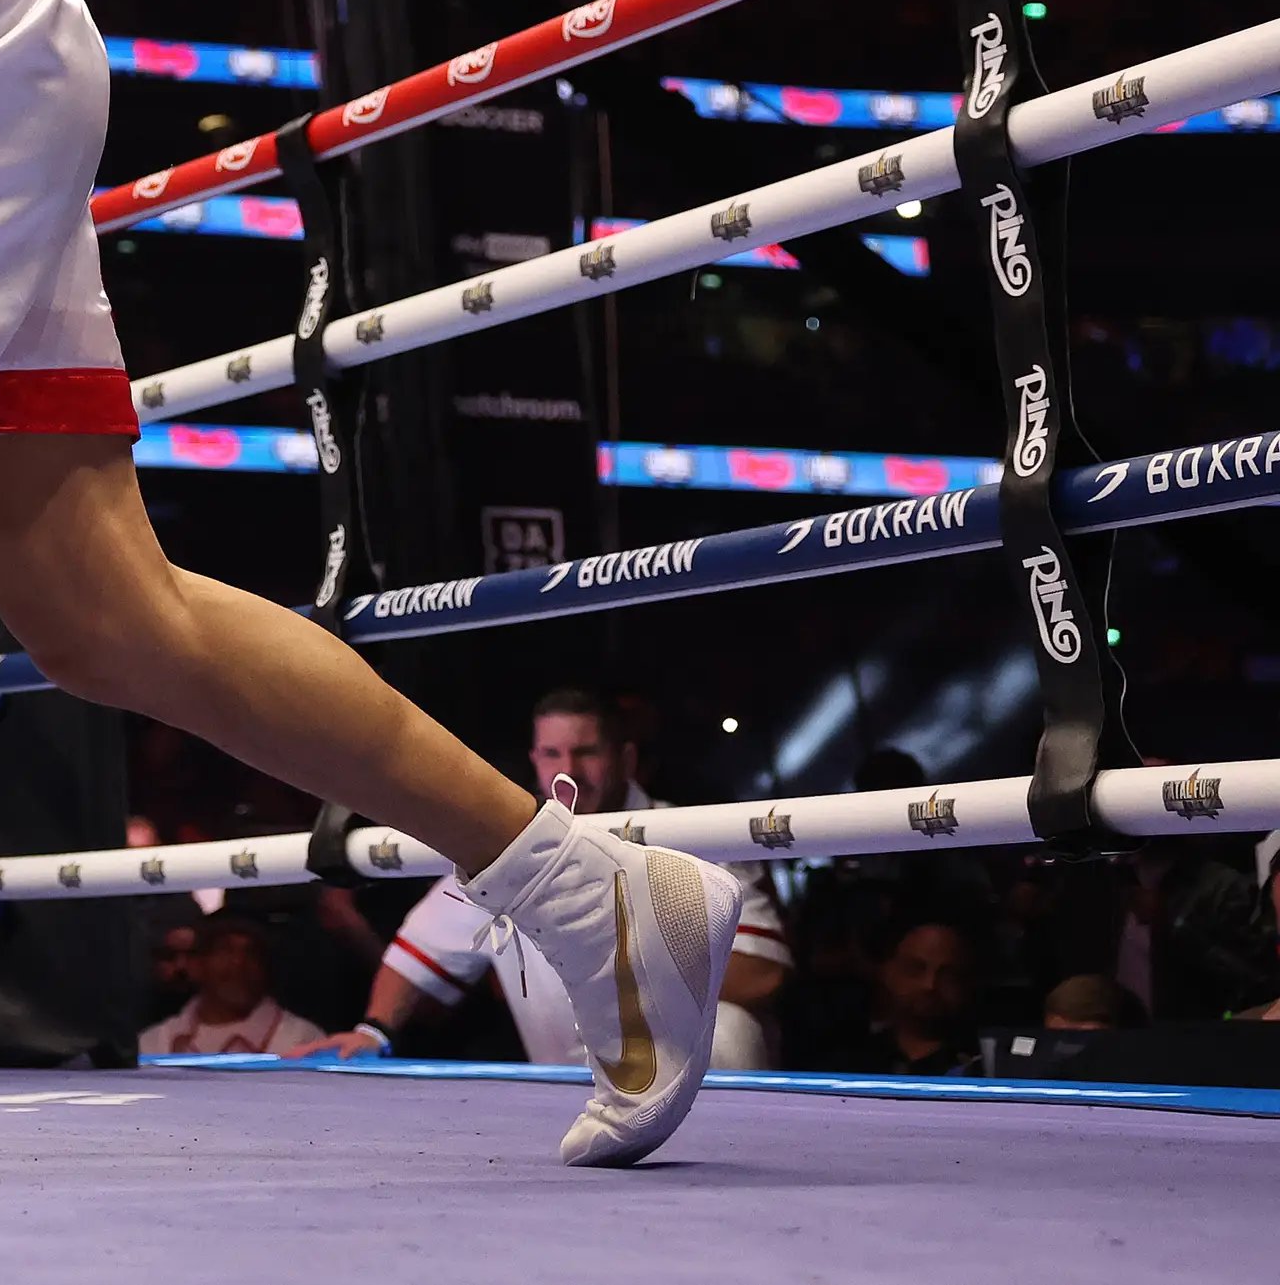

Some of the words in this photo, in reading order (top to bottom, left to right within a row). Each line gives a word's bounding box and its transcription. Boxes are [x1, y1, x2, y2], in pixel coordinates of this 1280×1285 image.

[968, 13, 1008, 119] RING
[980, 183, 1032, 297] RING
[1014, 364, 1051, 478] RING
[577, 538, 704, 588] BOXRAW
[824, 488, 976, 549] BOXRAW
[375, 576, 484, 618] BOXRAW
[1022, 546, 1082, 664] RING
